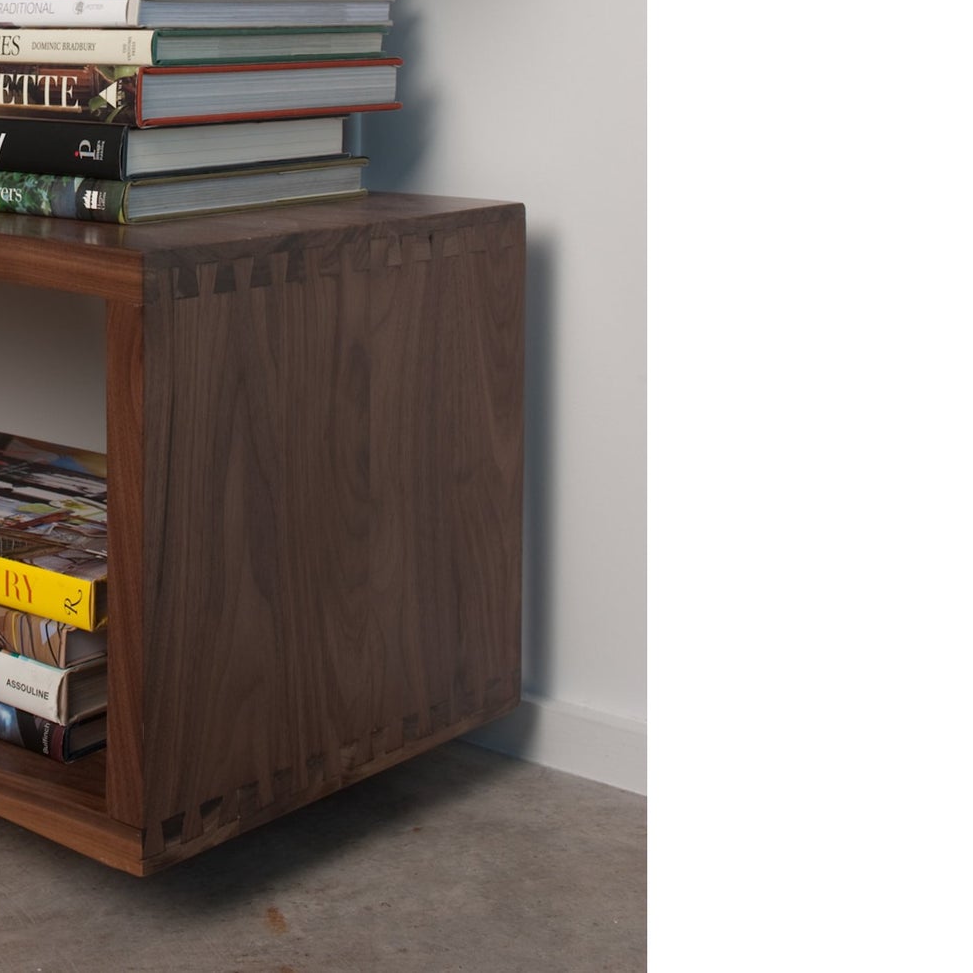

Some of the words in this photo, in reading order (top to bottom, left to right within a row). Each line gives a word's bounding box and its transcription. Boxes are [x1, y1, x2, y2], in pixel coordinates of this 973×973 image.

[31, 41, 62, 52] DOMINIC
[62, 42, 97, 52] BRADBURY
[6, 678, 49, 701] ASSOULINE
